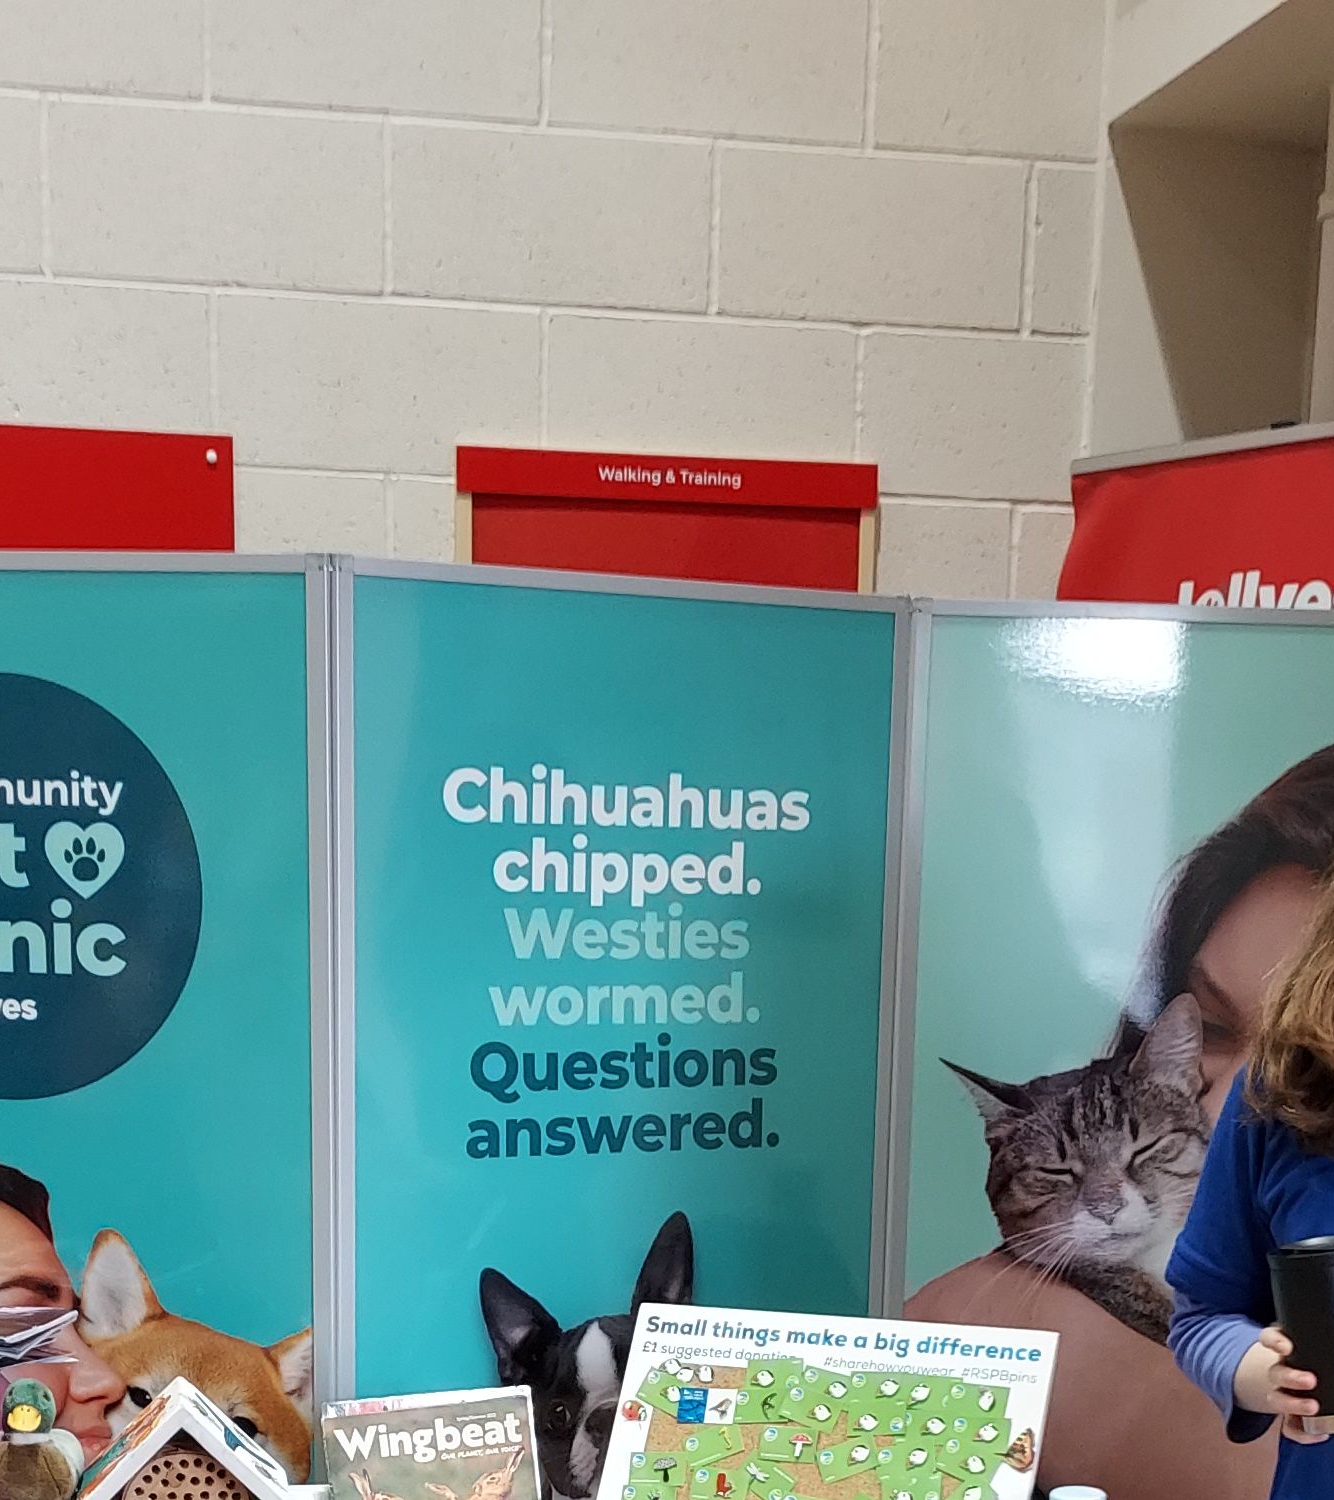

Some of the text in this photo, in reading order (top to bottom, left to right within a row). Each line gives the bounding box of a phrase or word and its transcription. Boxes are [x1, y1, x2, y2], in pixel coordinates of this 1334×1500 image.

[598, 465, 742, 489] Walking & Training
[442, 764, 811, 832] Chihuahuas
[493, 834, 762, 906] chipped.
[505, 903, 750, 961] Westies
[489, 972, 761, 1027] wormed.
[470, 1034, 778, 1105] Questions
[466, 1099, 780, 1160] answered.
[646, 1315, 1044, 1365] Small things make a big difference
[660, 1343, 732, 1363] suggested
[961, 1367, 1039, 1385] #RSPBpins
[333, 1412, 524, 1464] Wingbeat
